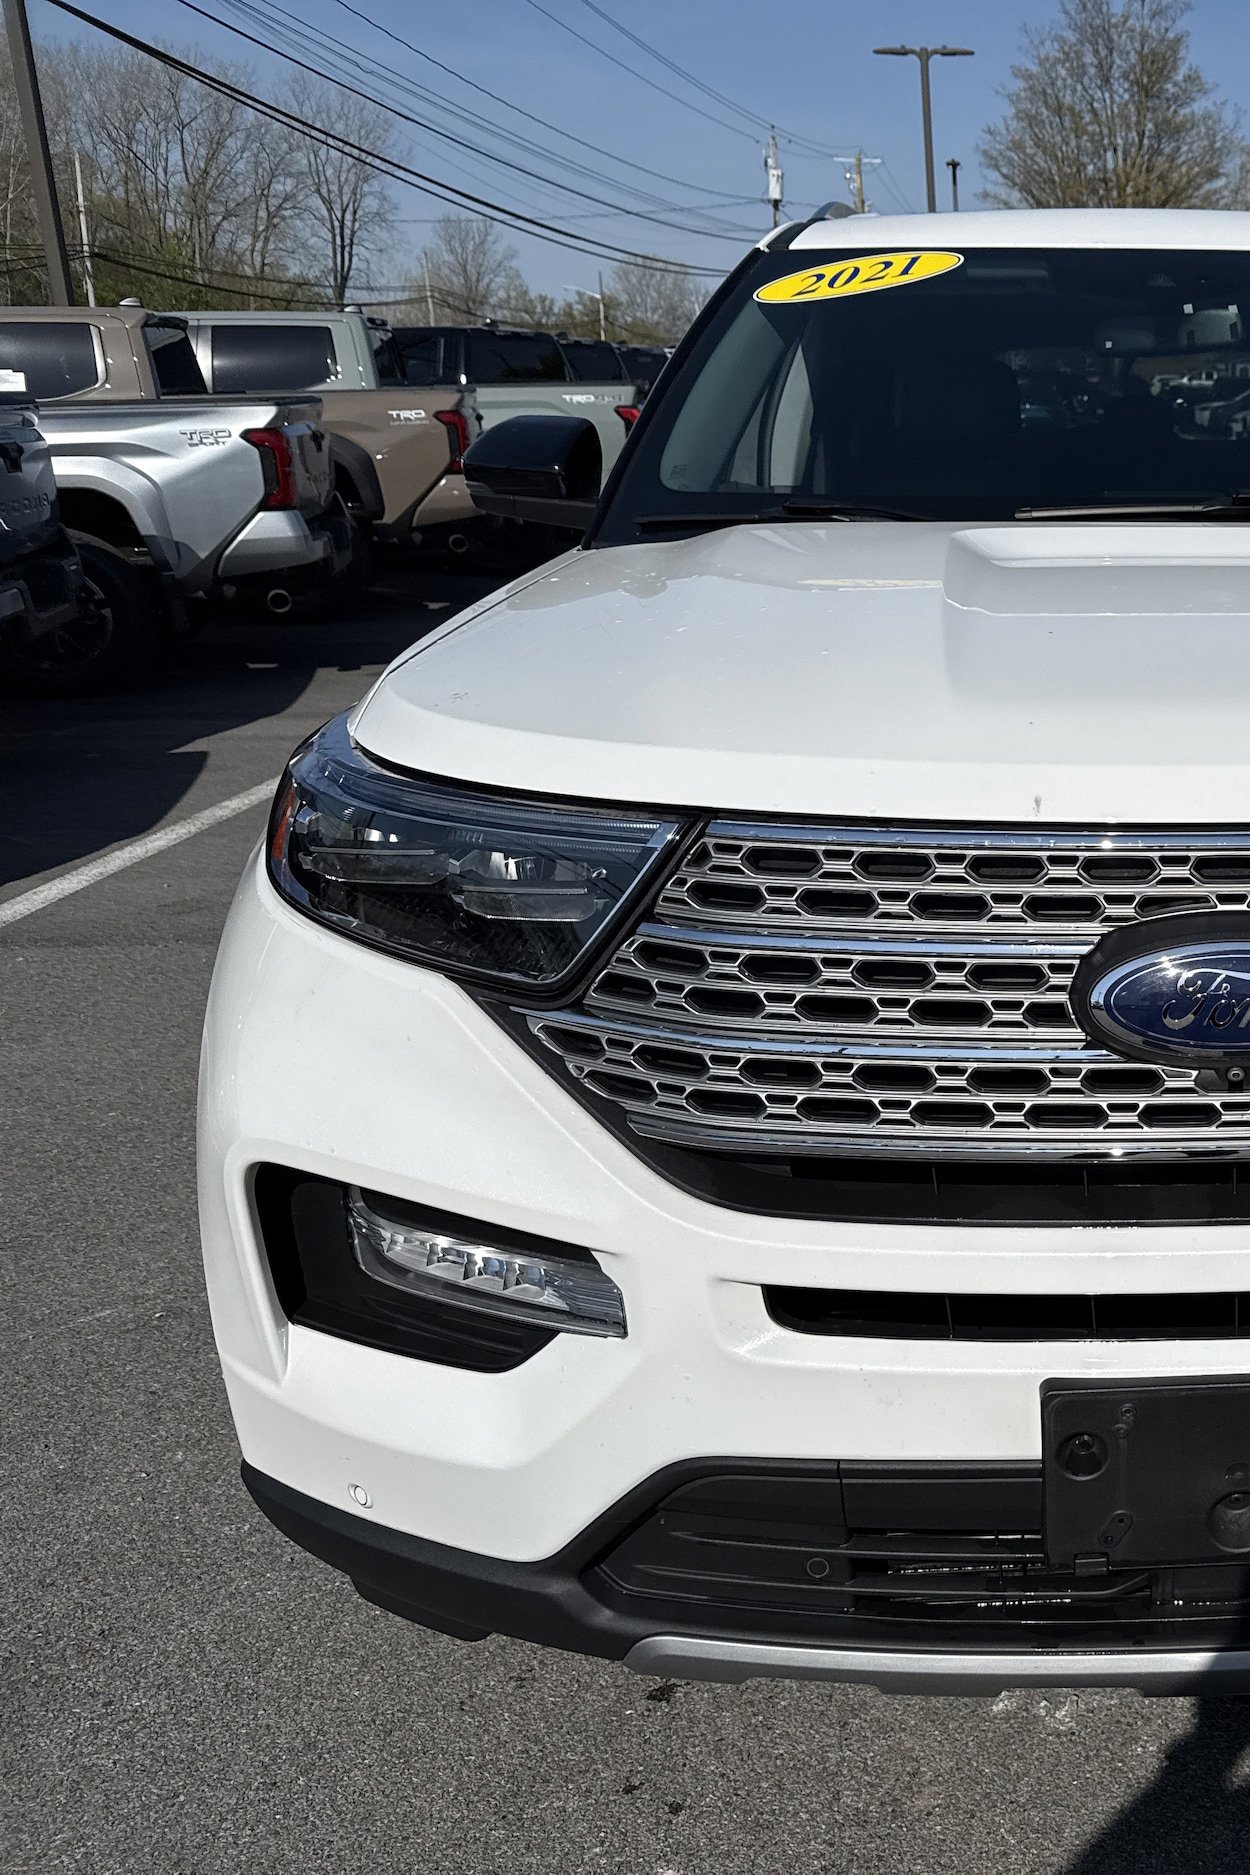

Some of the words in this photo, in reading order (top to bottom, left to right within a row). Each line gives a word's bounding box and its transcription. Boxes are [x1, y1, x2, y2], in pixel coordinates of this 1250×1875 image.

[790, 255, 921, 298] 2021
[387, 409, 426, 420] TRD
[179, 429, 232, 444] TRD
